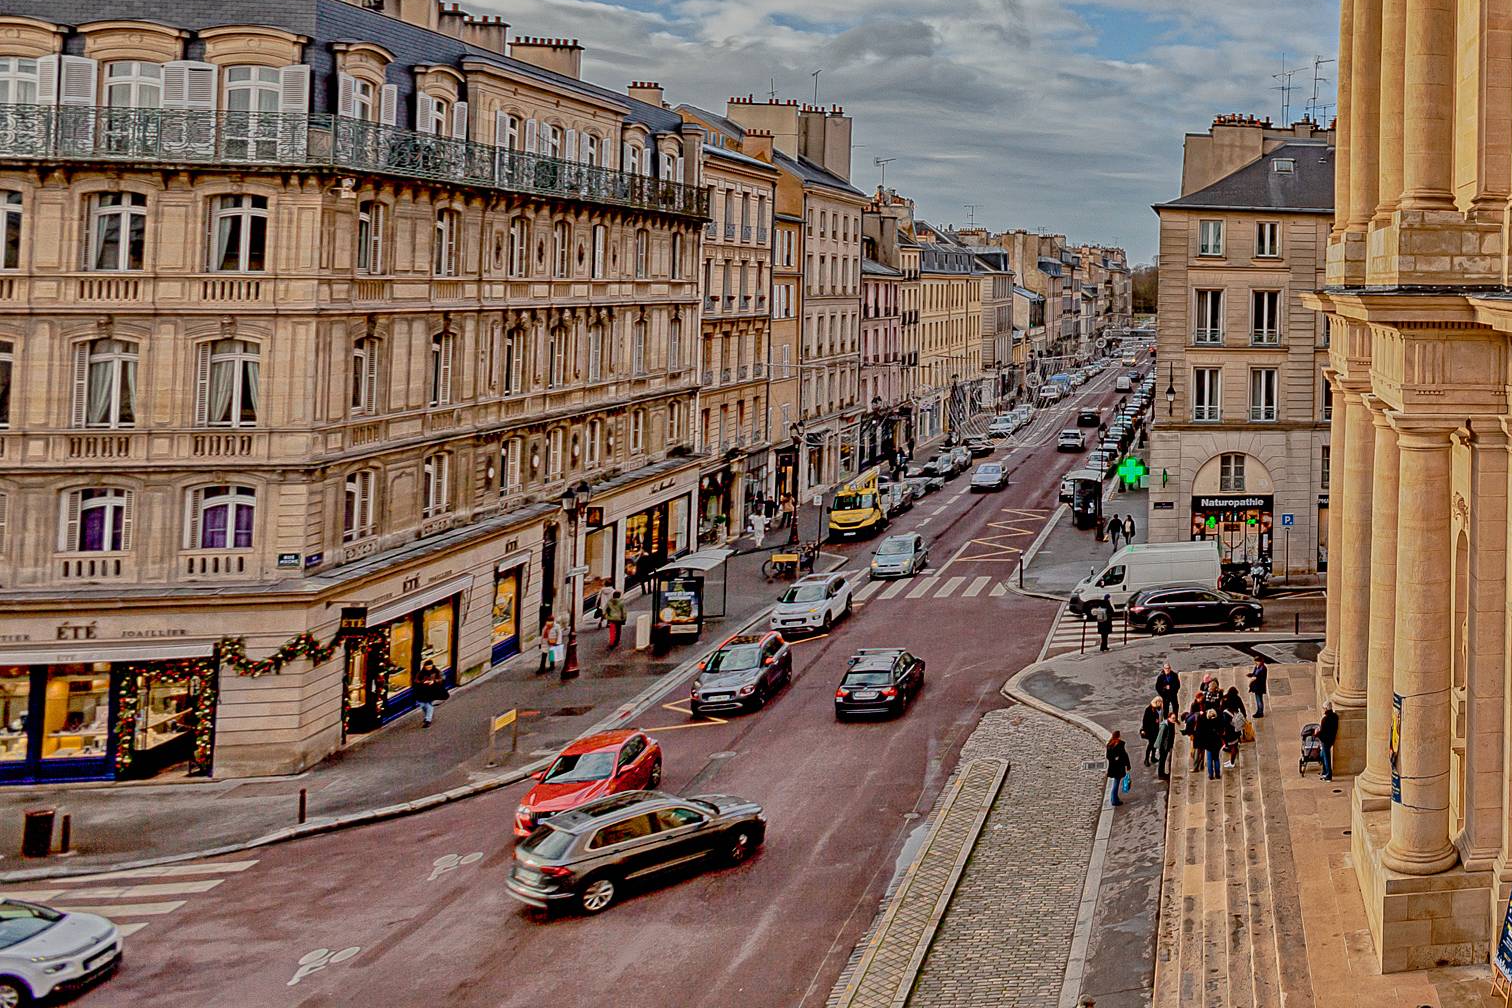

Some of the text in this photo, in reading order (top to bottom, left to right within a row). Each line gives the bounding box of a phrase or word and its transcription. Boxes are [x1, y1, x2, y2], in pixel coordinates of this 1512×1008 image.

[1201, 498, 1264, 508] Naturopathie
[505, 536, 519, 553] ÉTÉ
[403, 573, 421, 594] ÉTÉ
[56, 621, 98, 640] ÉTÉ
[121, 629, 188, 638] JOAILLIER
[342, 618, 365, 628] ÉTÉ
